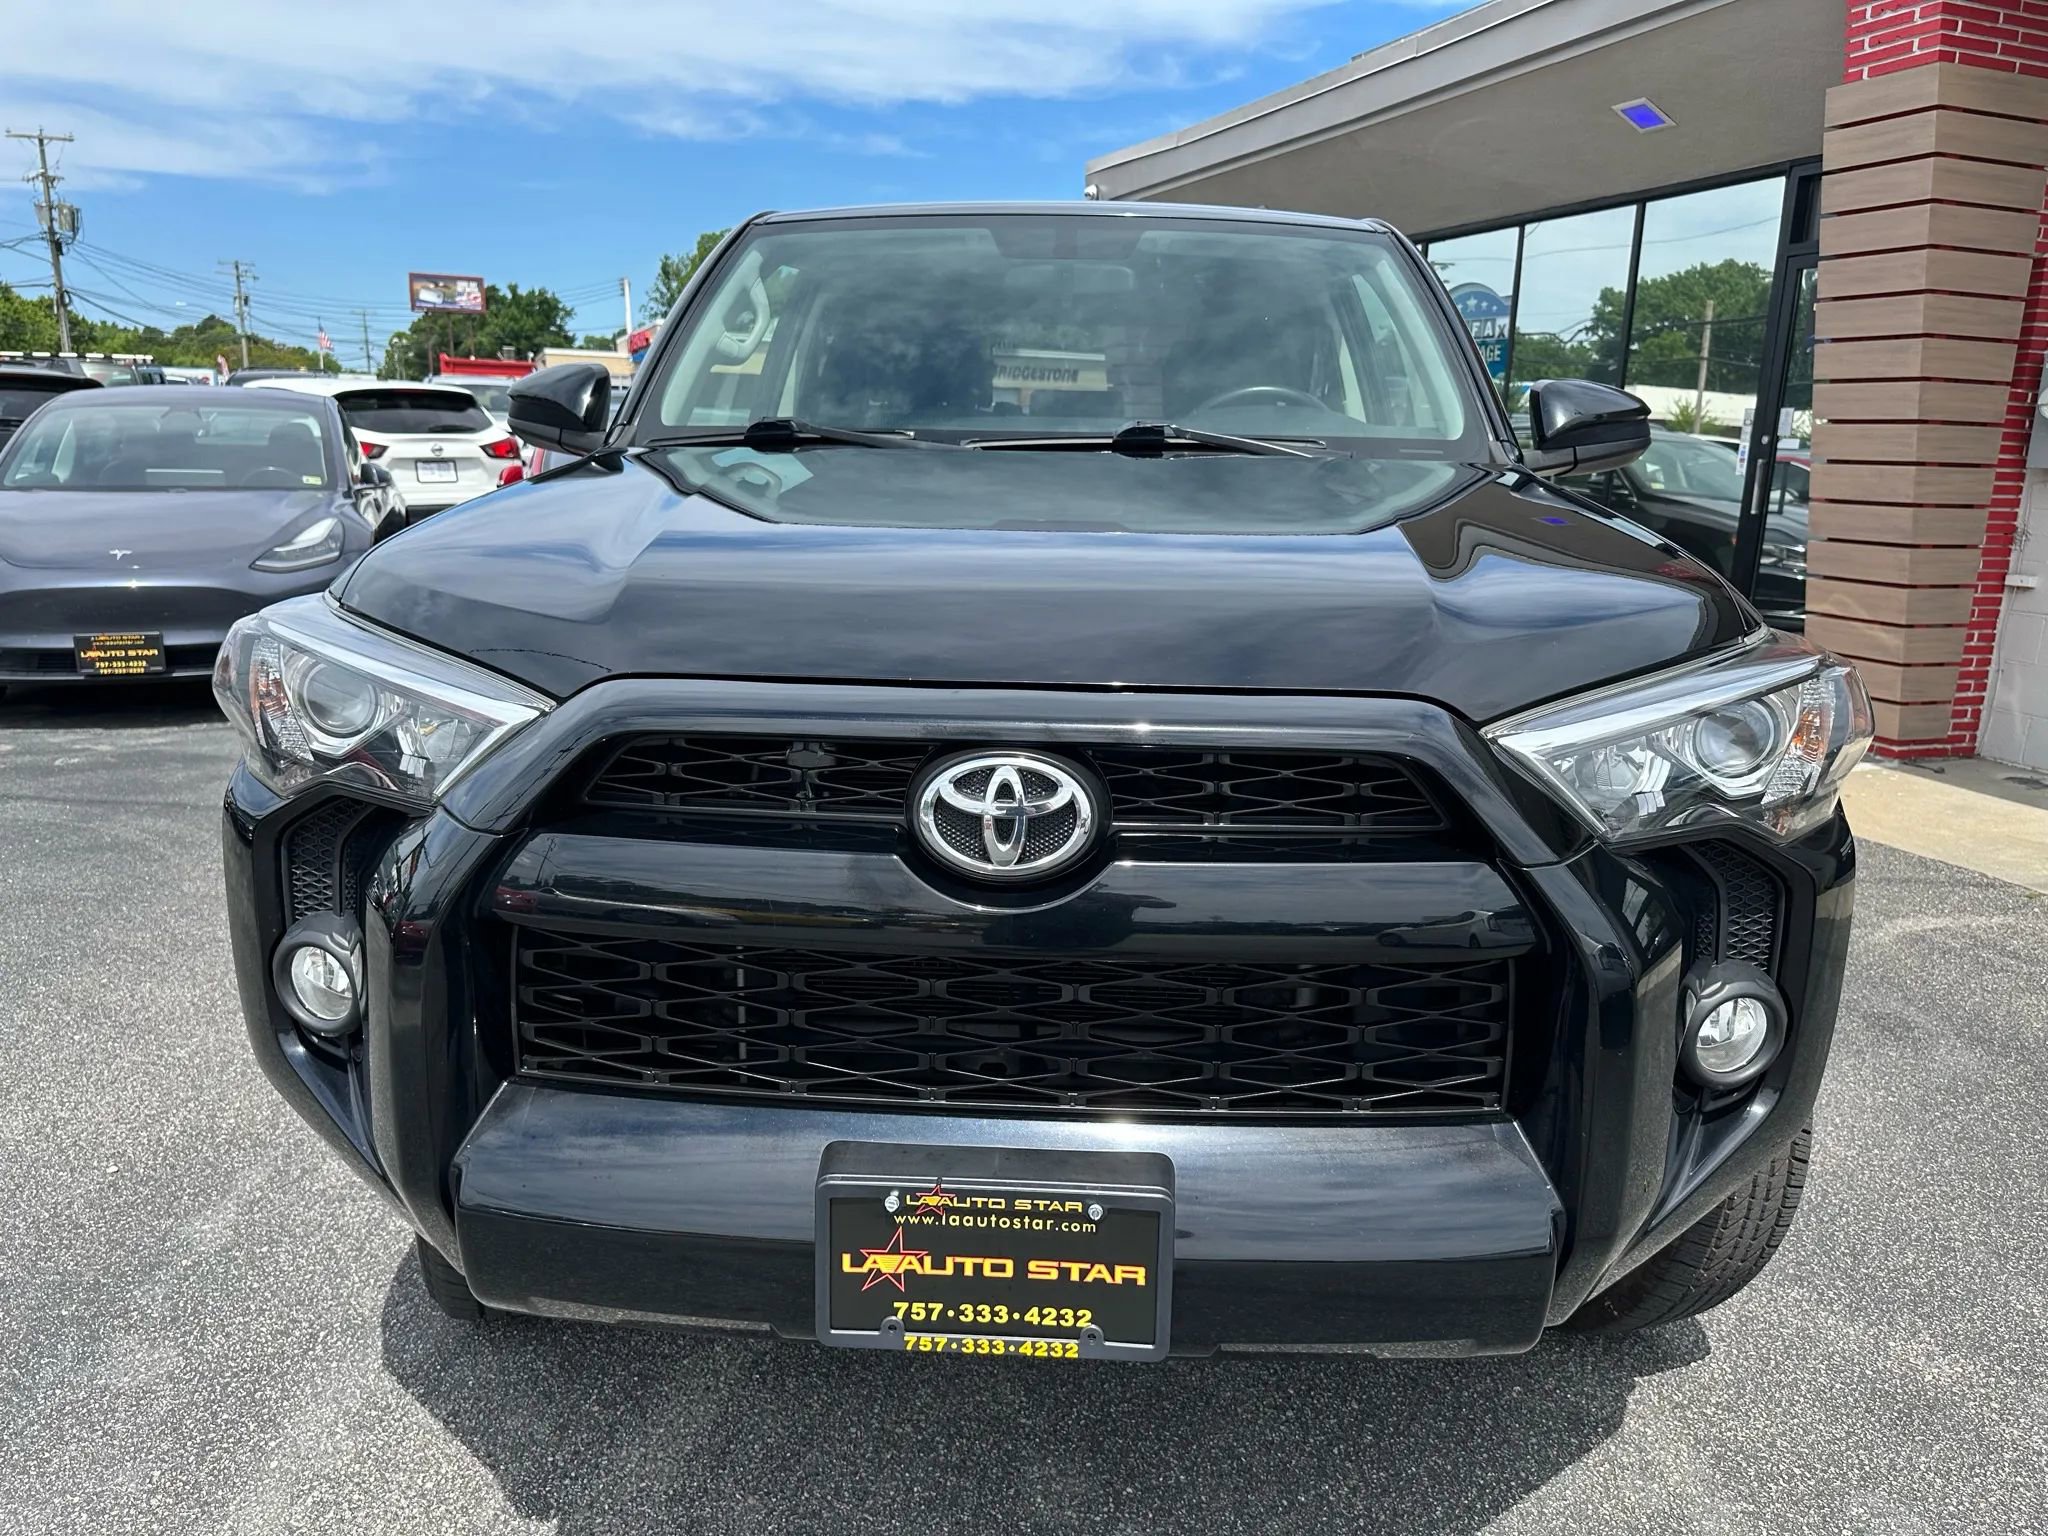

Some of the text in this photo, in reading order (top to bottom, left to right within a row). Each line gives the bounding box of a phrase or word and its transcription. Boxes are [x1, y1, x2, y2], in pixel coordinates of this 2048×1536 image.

[1471, 321, 1506, 338] FAX
[127, 649, 159, 657] STAR
[1014, 1199, 1083, 1213] STAR
[893, 1210, 1097, 1233] www.laautostar.com
[1027, 1259, 1147, 1286] STAR
